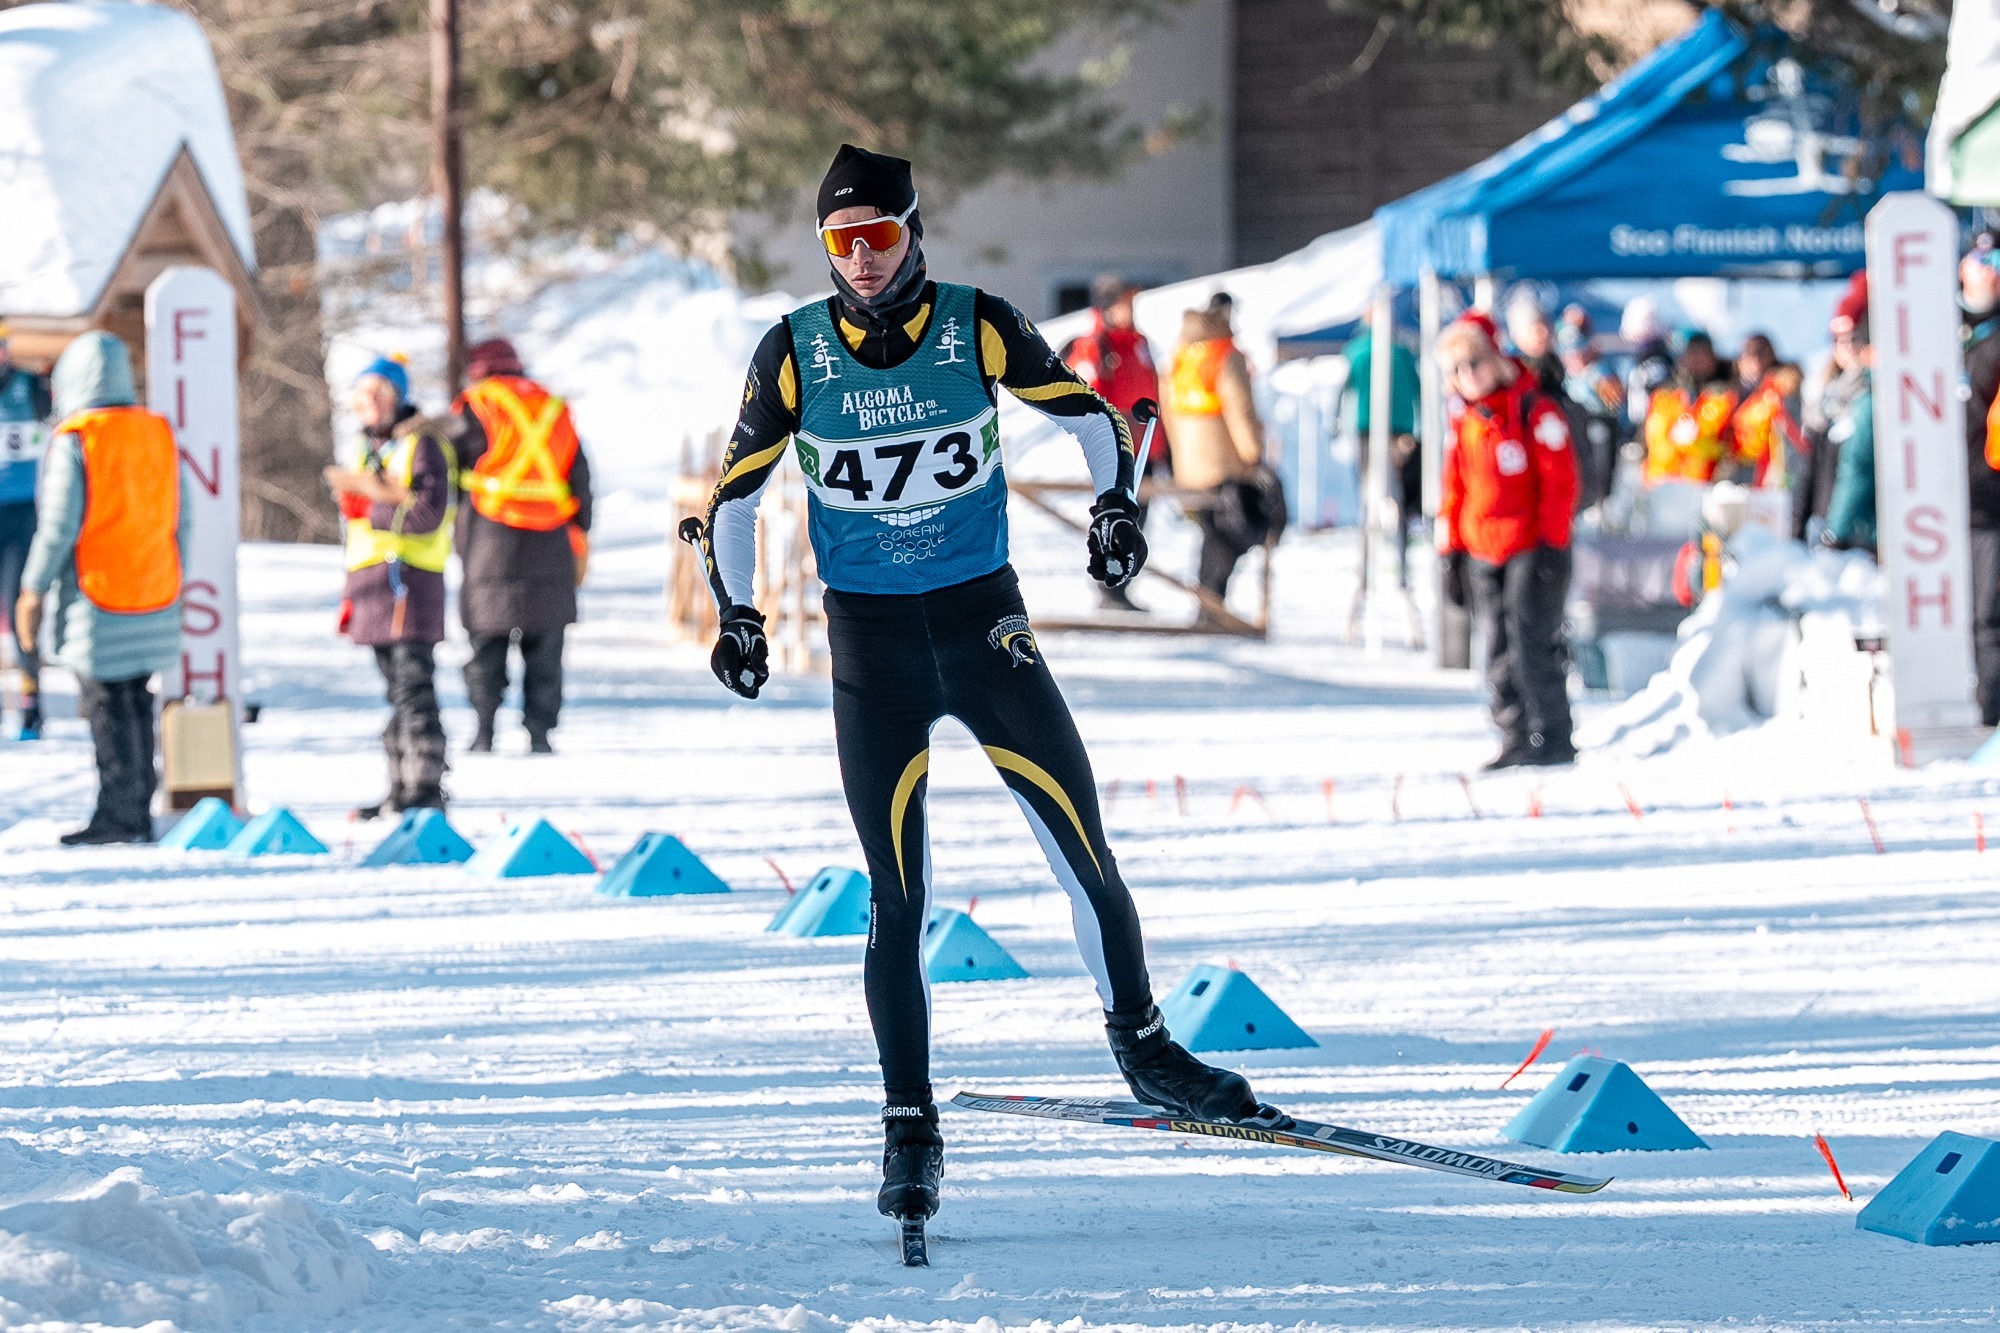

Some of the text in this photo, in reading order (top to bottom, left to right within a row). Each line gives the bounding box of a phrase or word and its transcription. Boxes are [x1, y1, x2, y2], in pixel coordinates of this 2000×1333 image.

[1673, 223, 1781, 256] Finnish
[1784, 222, 1866, 255] Nordi
[841, 385, 914, 414] ALGOMA
[858, 399, 938, 431] BICYCLE CO.
[1893, 232, 1953, 629] FINISH
[800, 448, 816, 475] 73
[823, 431, 979, 501] 473
[173, 308, 226, 699] FINSH
[870, 902, 878, 949] GARNEAU
[882, 1106, 923, 1117] SSIGNOL
[1173, 1122, 1275, 1143] SALOMON
[1365, 1136, 1513, 1177] SALOMON
